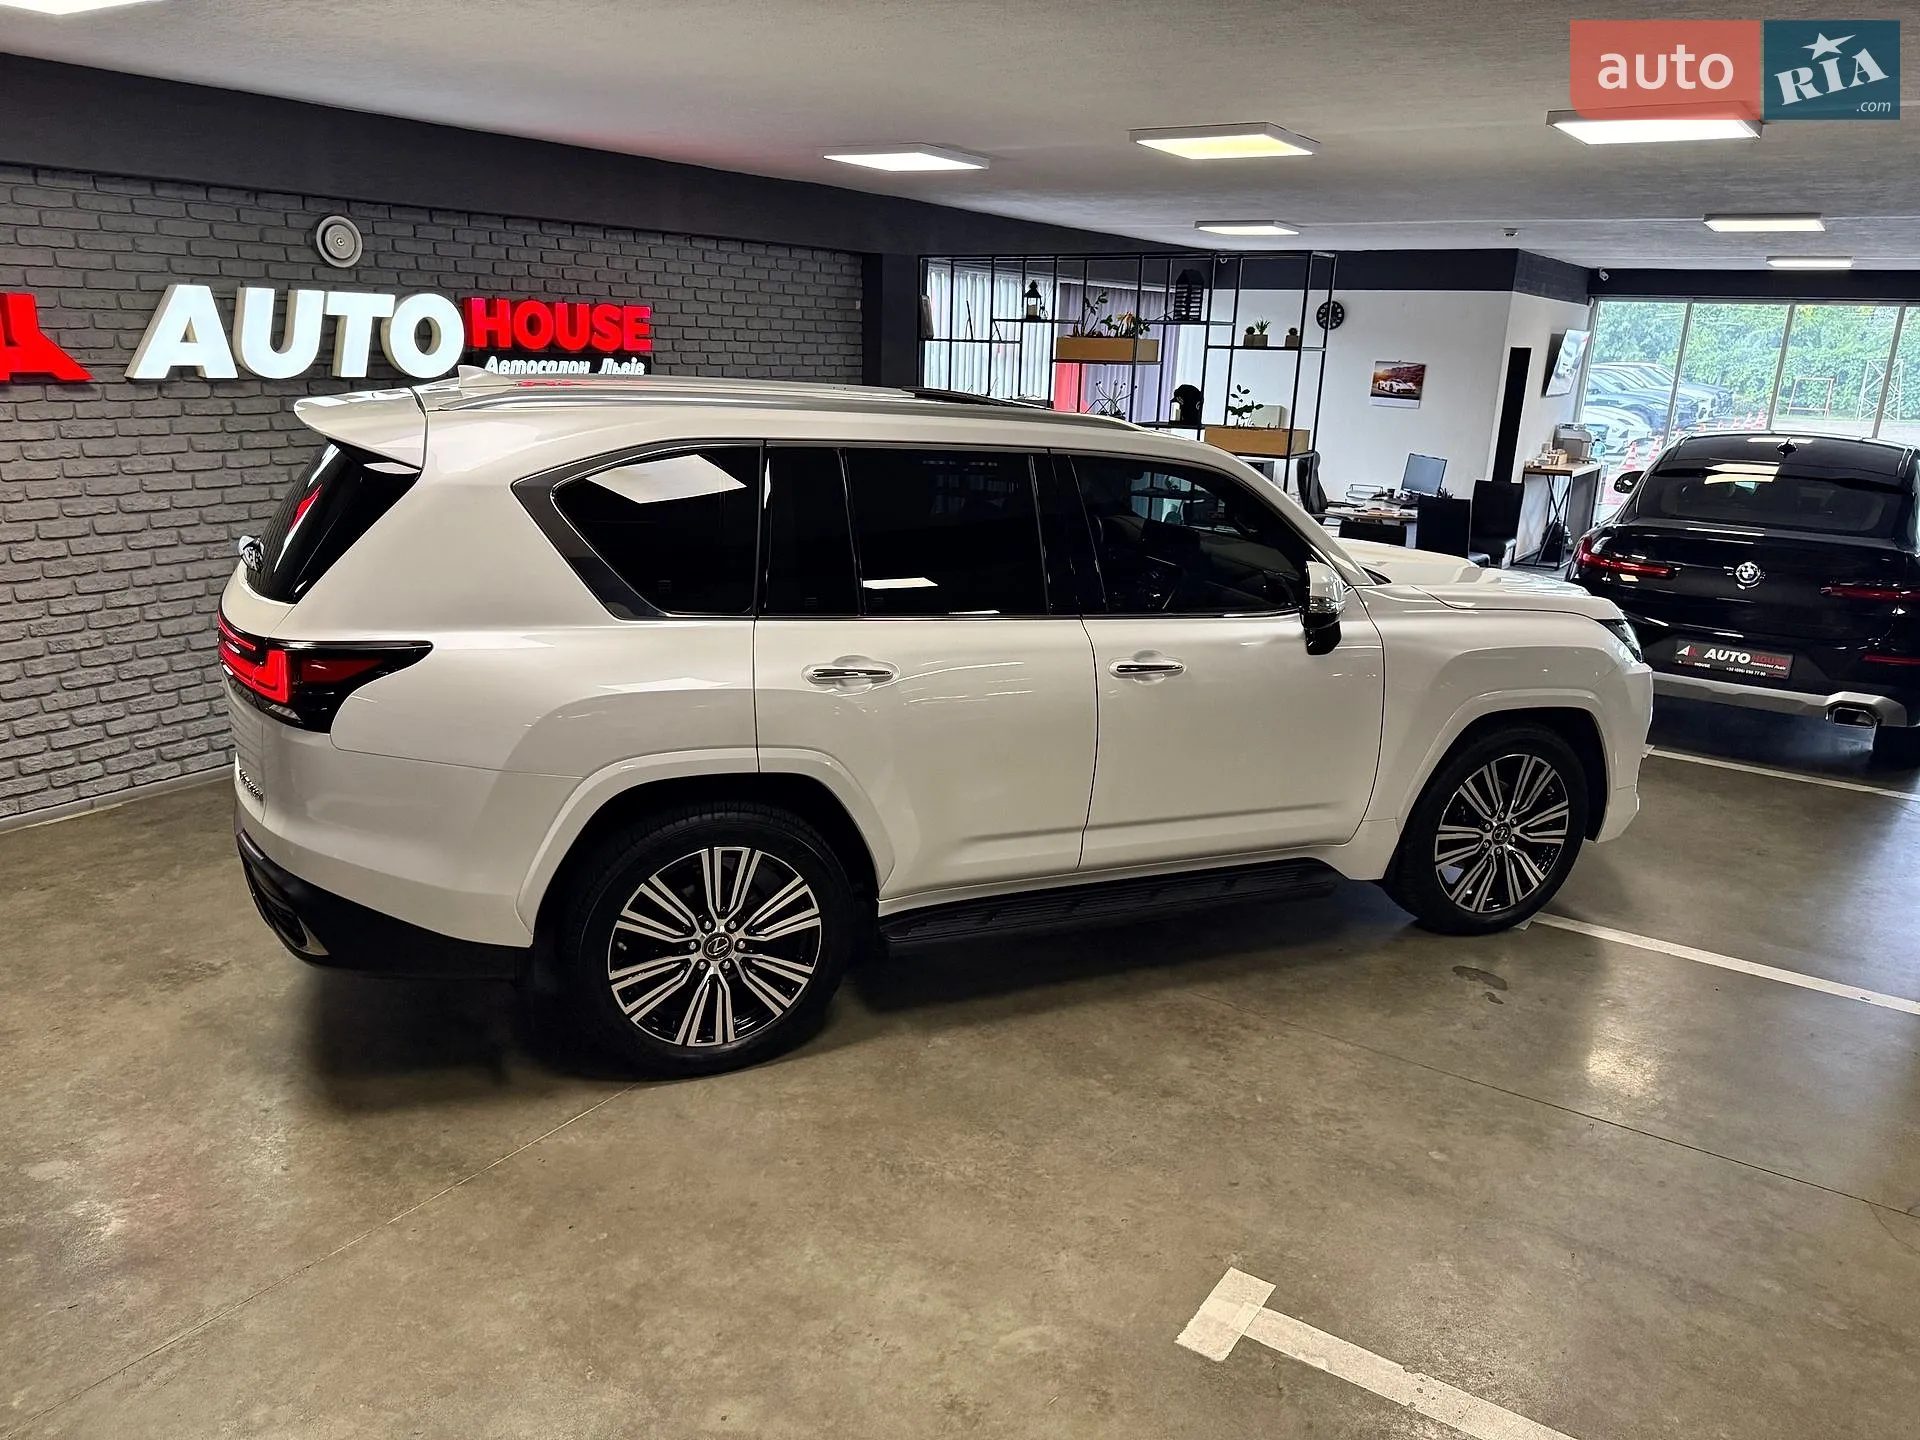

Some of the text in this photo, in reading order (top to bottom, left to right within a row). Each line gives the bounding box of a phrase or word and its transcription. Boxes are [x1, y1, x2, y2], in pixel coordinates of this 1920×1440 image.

[125, 284, 465, 380] AUTO
[463, 297, 653, 352] HOUSE
[598, 357, 645, 375] Львів
[1703, 648, 1751, 664] AUTO
